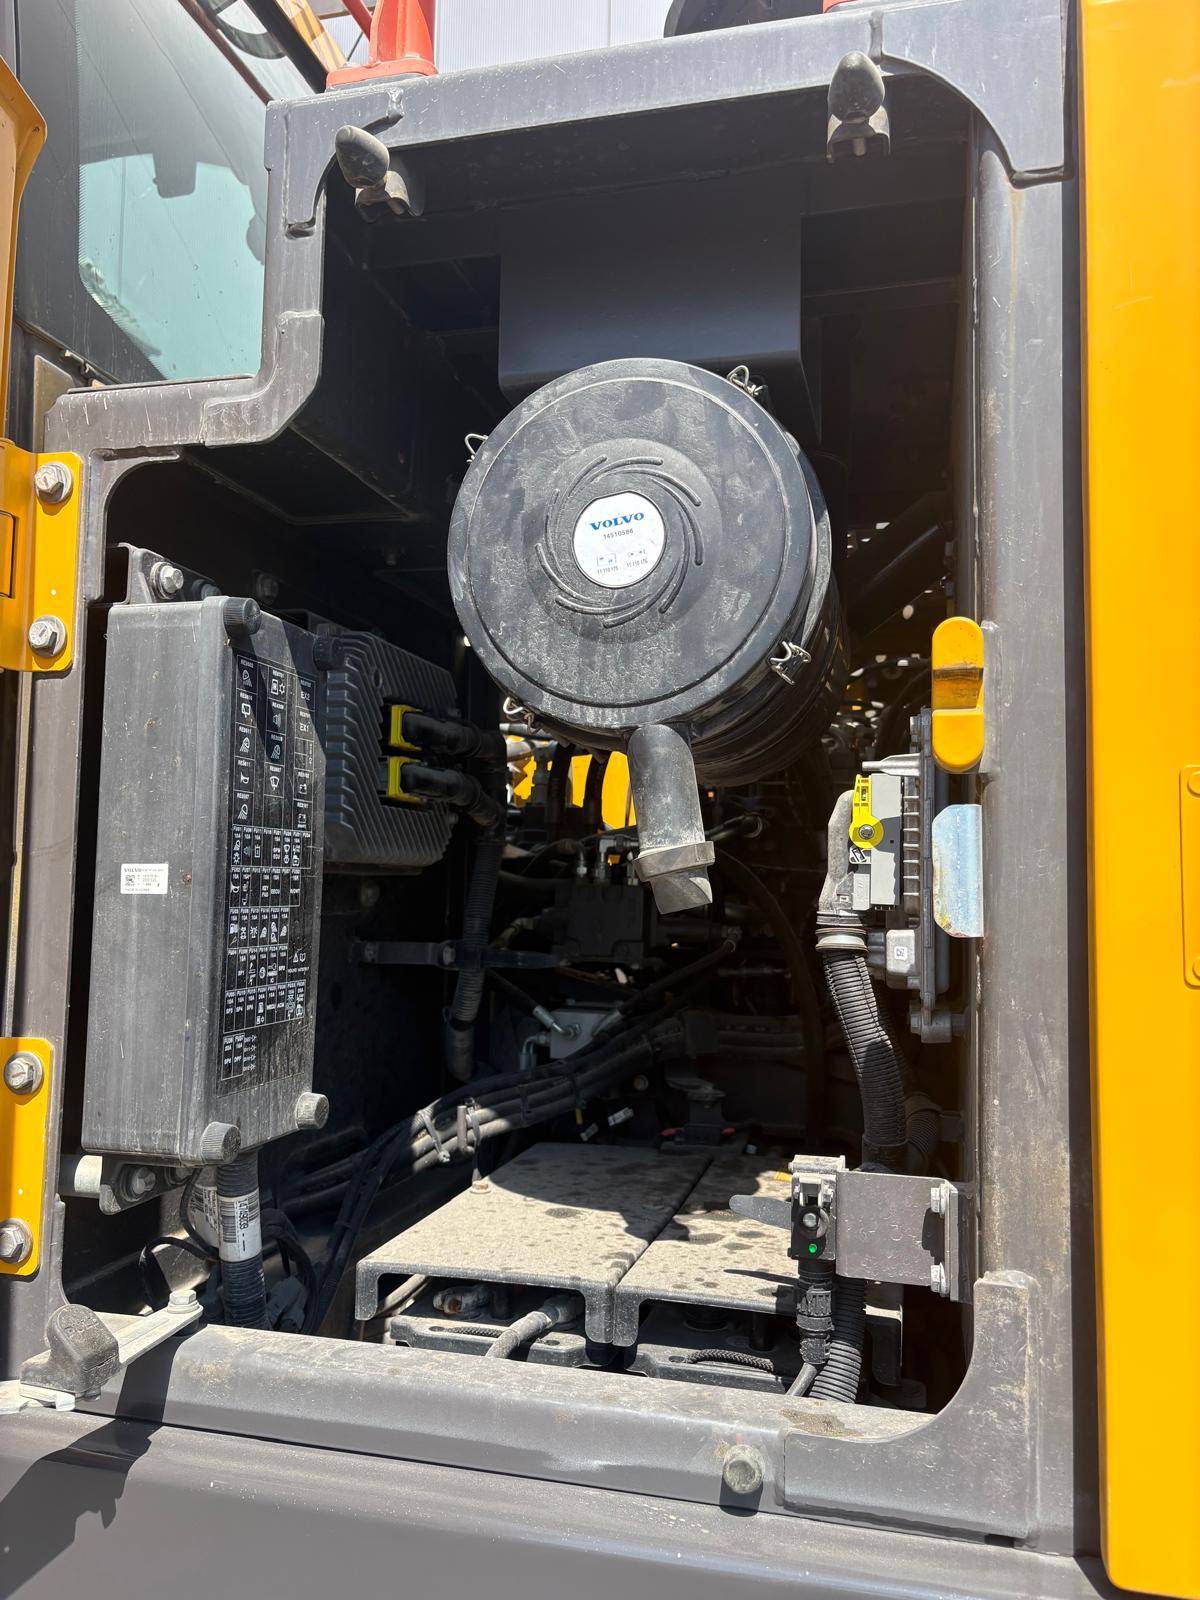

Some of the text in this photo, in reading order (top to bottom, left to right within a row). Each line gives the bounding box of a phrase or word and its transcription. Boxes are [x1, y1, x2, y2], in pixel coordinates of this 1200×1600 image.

[589, 512, 645, 531] VOLVO
[603, 528, 634, 540] 14510586
[300, 691, 310, 701] EX2
[299, 722, 309, 732] EX1
